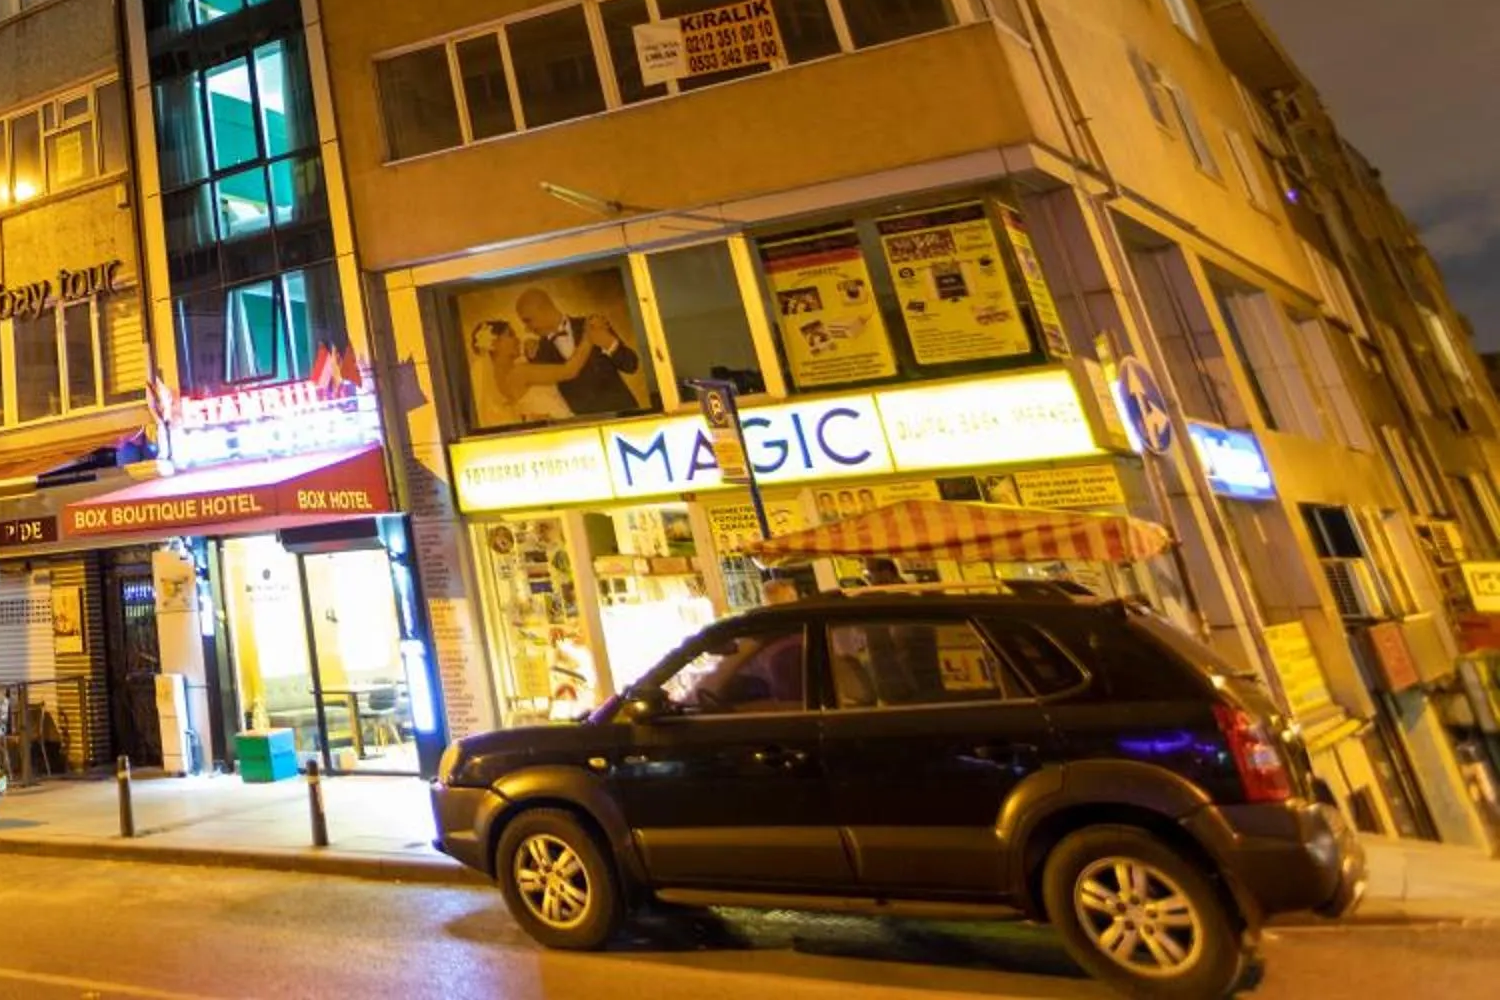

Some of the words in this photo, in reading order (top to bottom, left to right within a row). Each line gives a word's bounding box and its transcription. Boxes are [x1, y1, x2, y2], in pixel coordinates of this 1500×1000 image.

[57, 258, 122, 299] tour
[615, 407, 873, 487] MAGIC
[74, 508, 108, 530] BOX
[111, 499, 198, 526] BOUTIQUE
[201, 494, 262, 518] HOTEL
[297, 489, 326, 510] BOX
[329, 491, 373, 510] HOTEL
[4, 521, 44, 542] PDE
